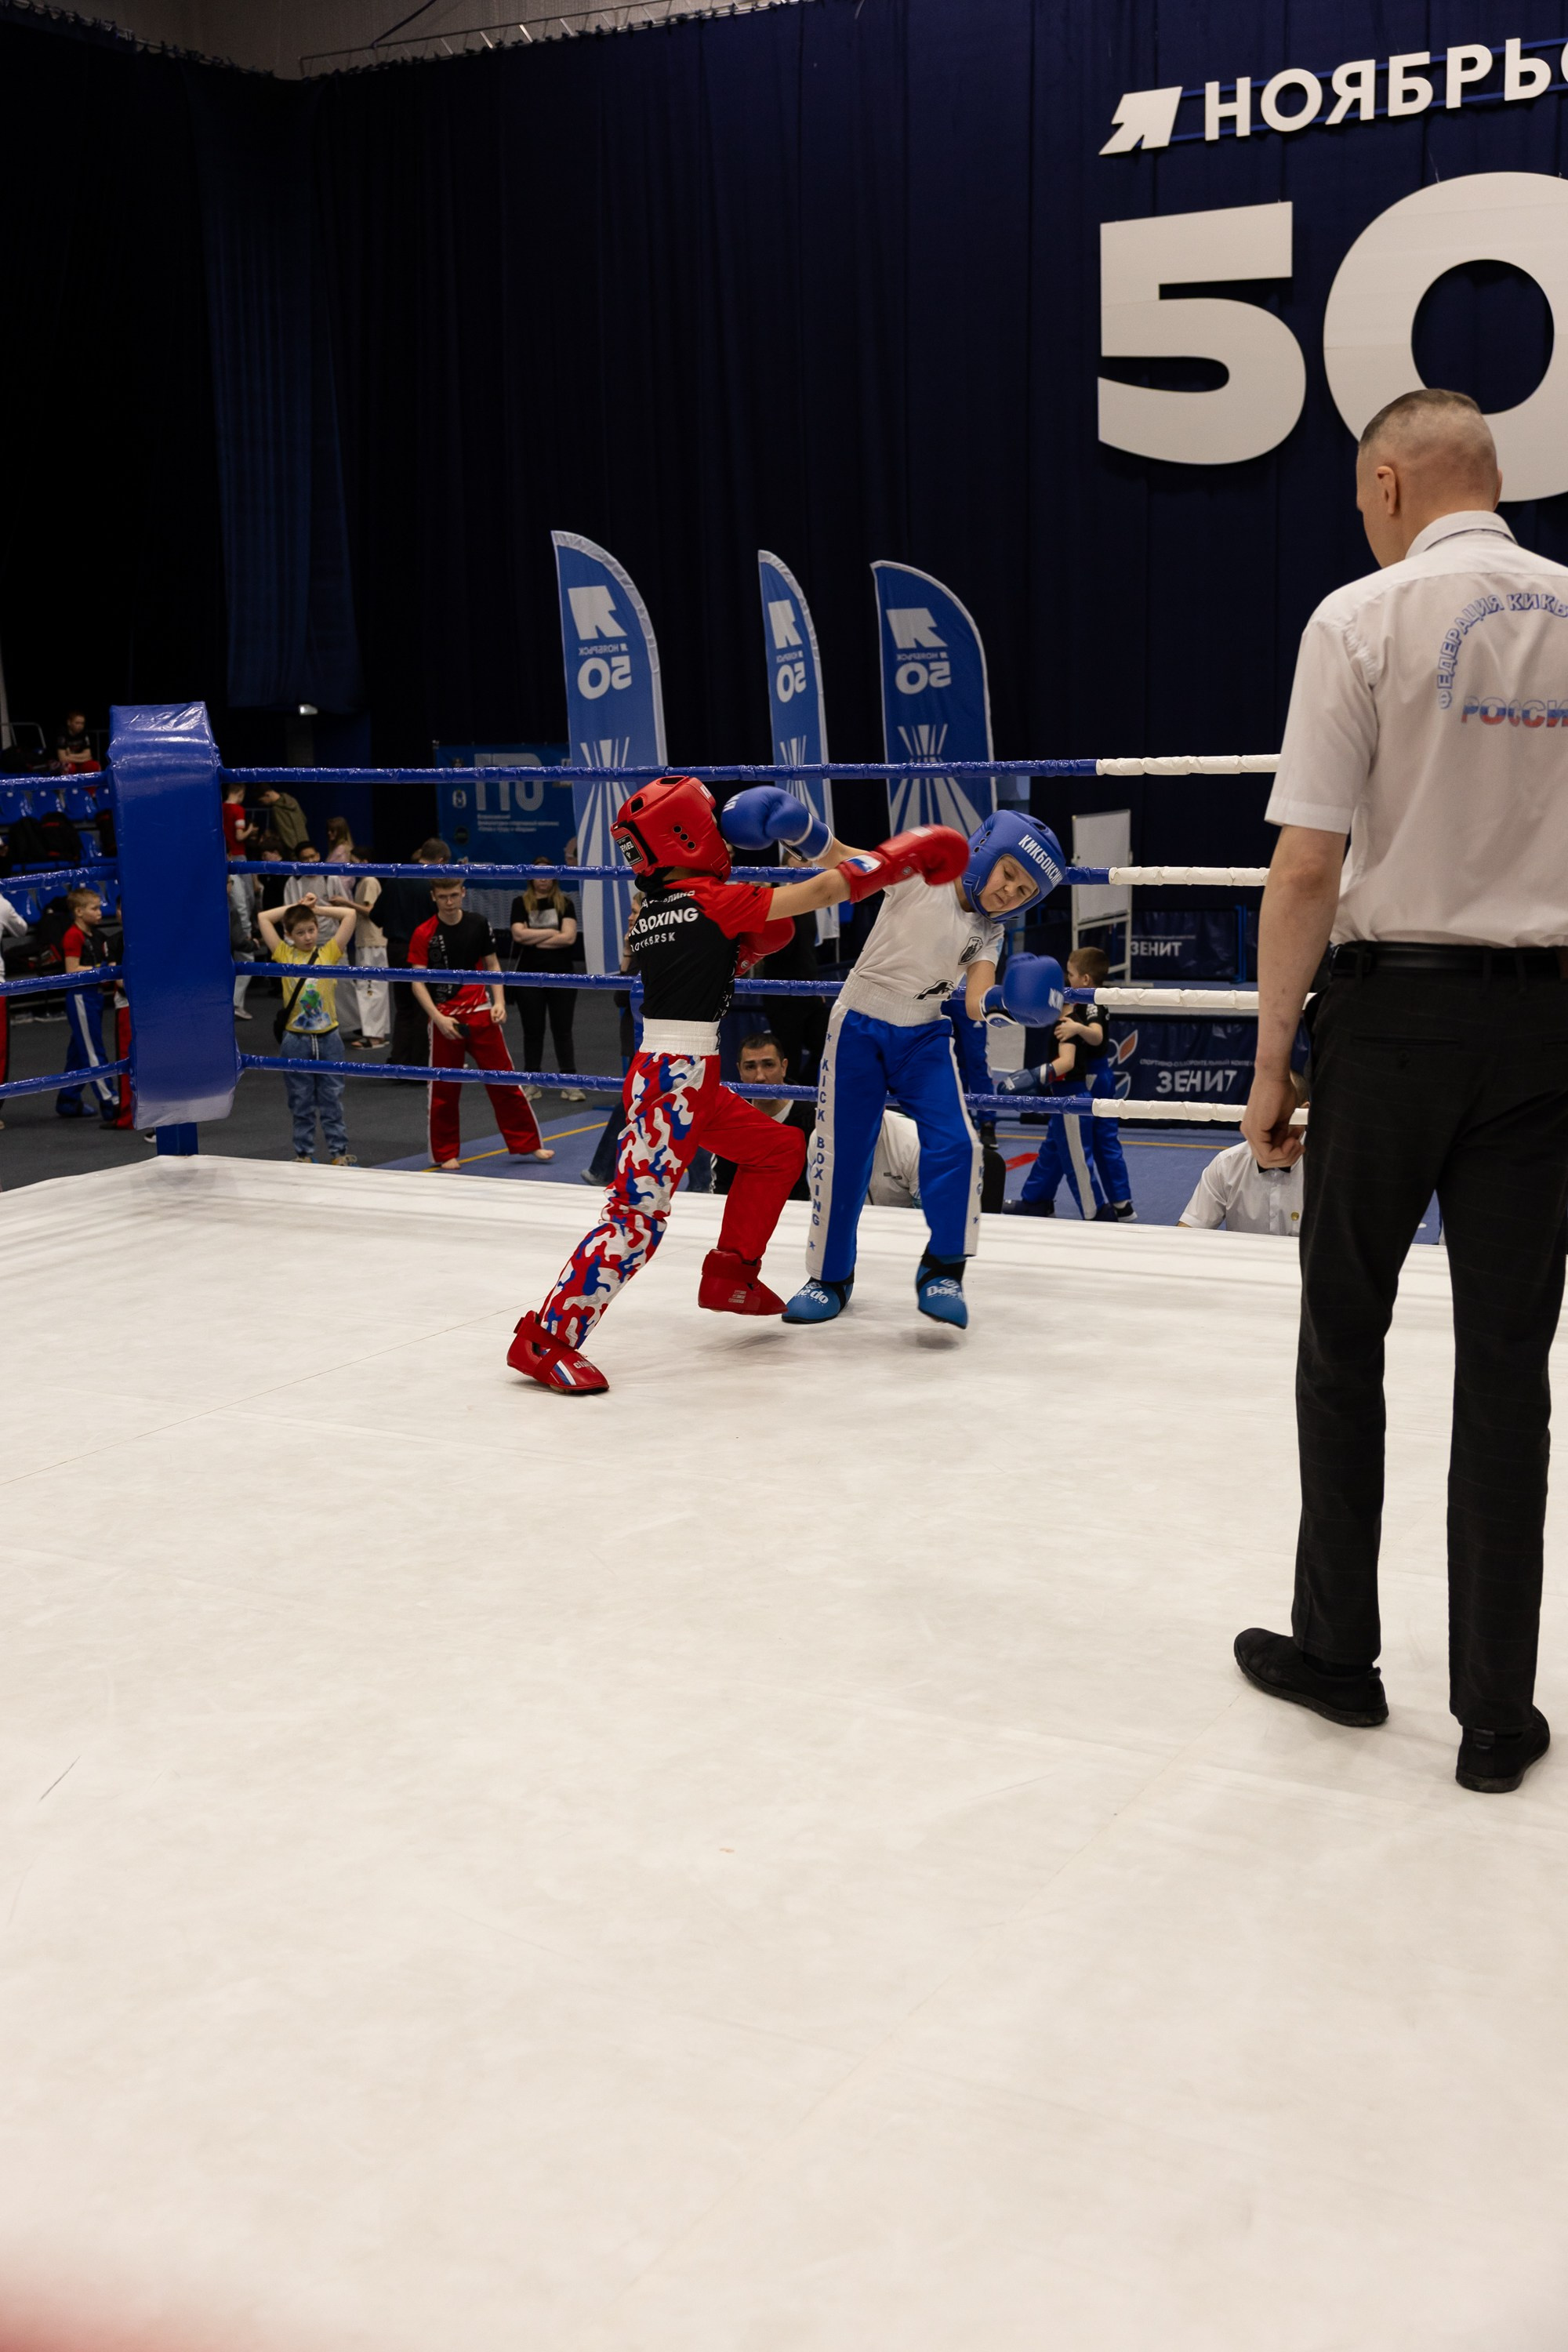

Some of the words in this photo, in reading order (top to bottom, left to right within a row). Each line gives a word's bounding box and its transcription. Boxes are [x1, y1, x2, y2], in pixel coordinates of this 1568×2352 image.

[1204, 38, 1568, 141] НОЯБРЬ
[1098, 172, 1568, 503] 50
[1437, 594, 1504, 710] ФЕДЕРАЦИЯ
[1131, 941, 1182, 957] ЗЕНИТ
[817, 1058, 829, 1122] KICK
[1156, 1069, 1238, 1093] ЗЕНИТ
[812, 1137, 826, 1226] BOXING
